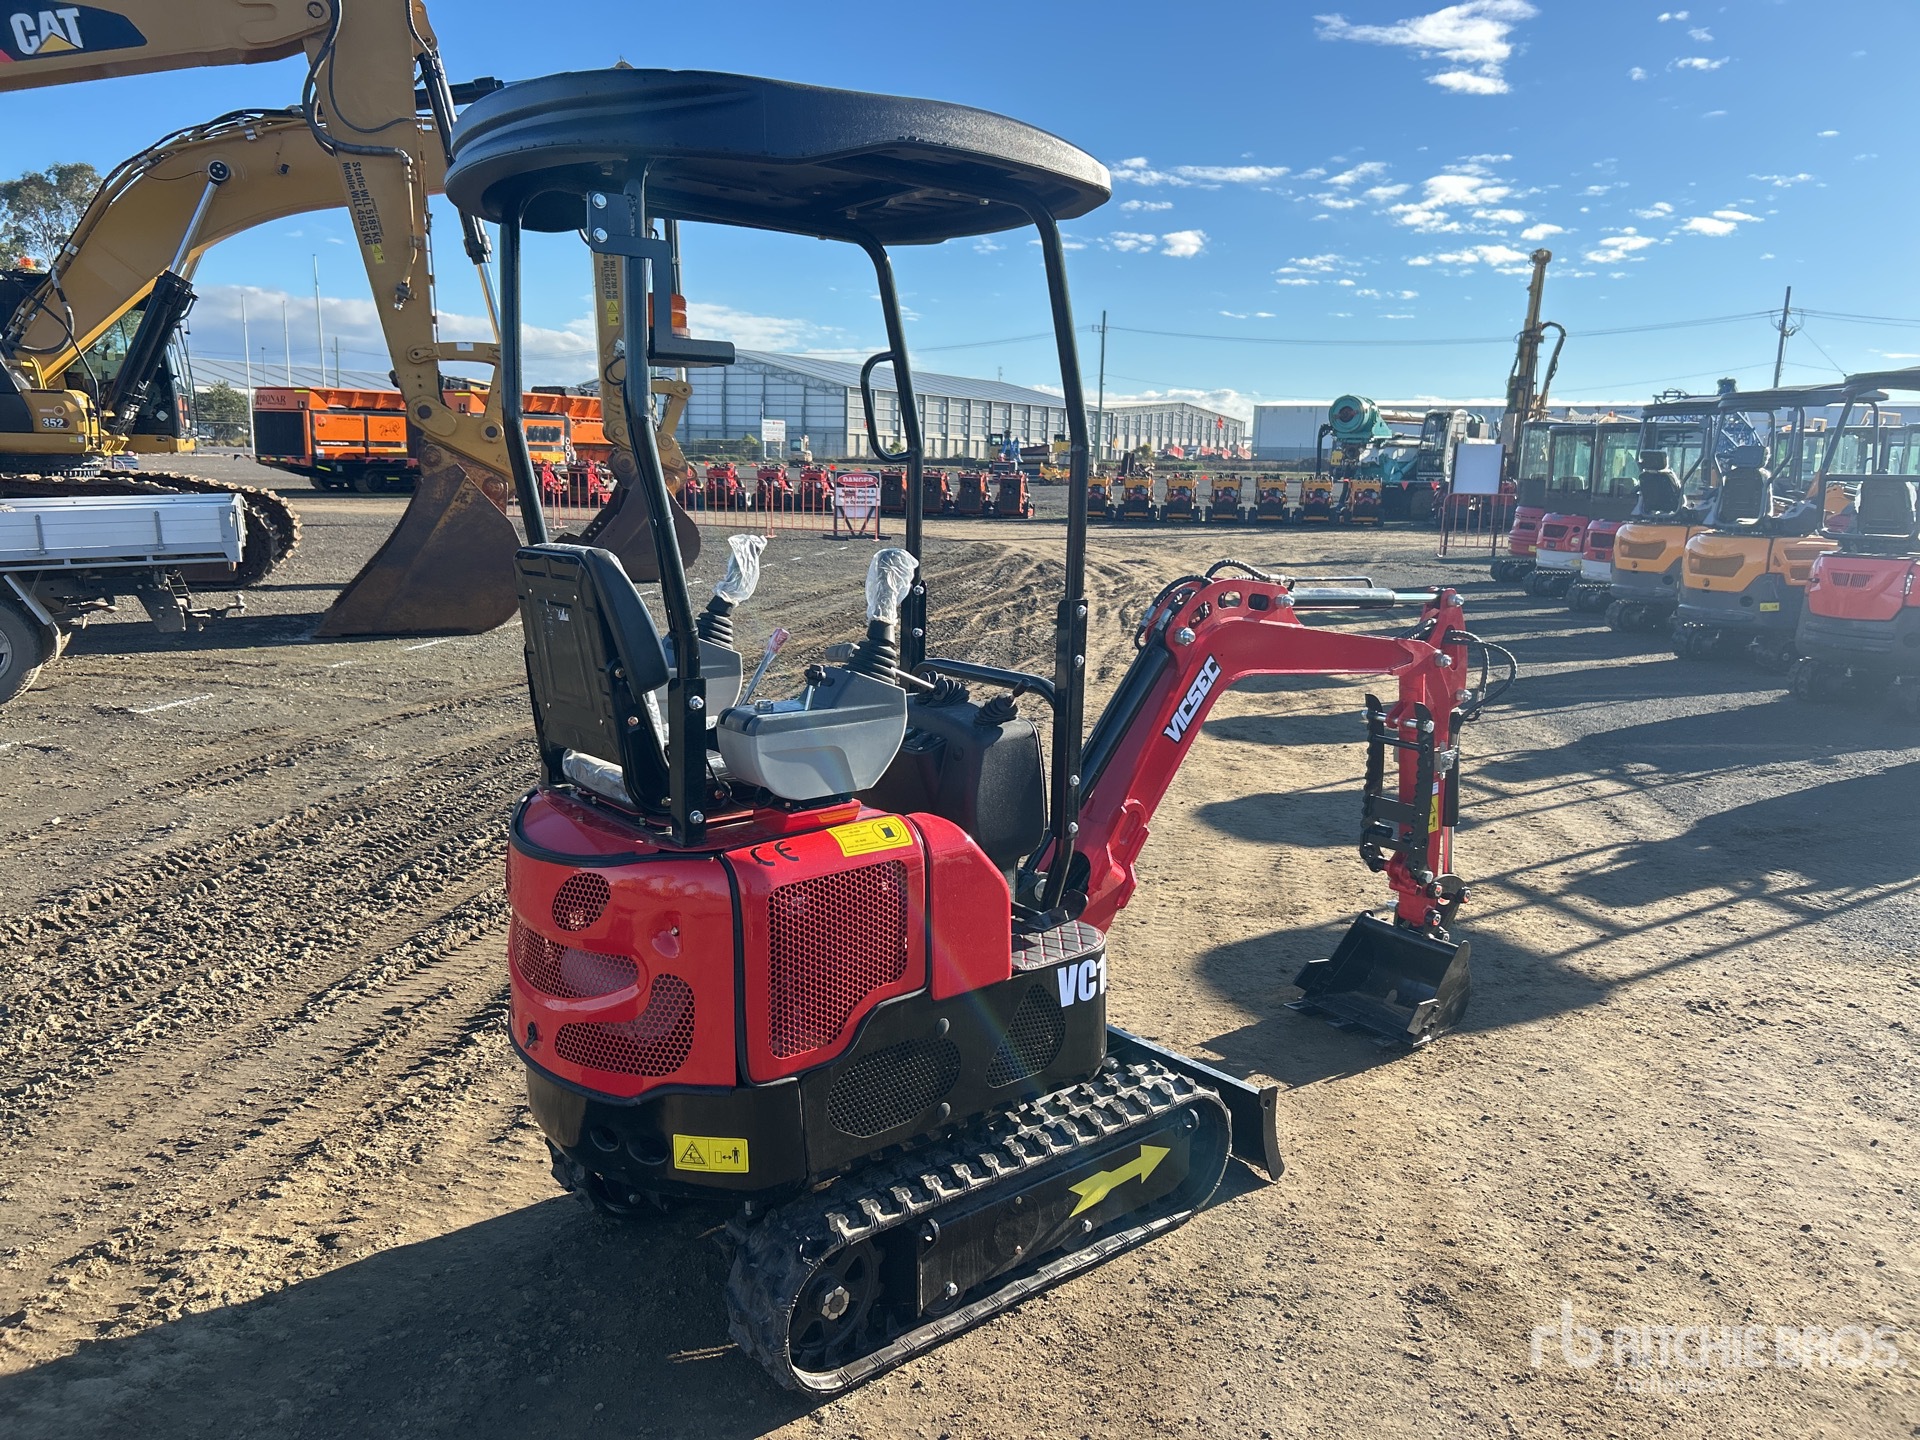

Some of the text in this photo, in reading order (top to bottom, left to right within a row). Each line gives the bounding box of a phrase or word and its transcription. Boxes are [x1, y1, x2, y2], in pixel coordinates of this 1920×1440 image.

[10, 7, 84, 55] CAT
[342, 162, 374, 245] Mobile WLL 4563 KG
[352, 161, 382, 244] Static WLL 5185 KG
[42, 417, 64, 428] 352
[1163, 654, 1222, 743] VICSEC
